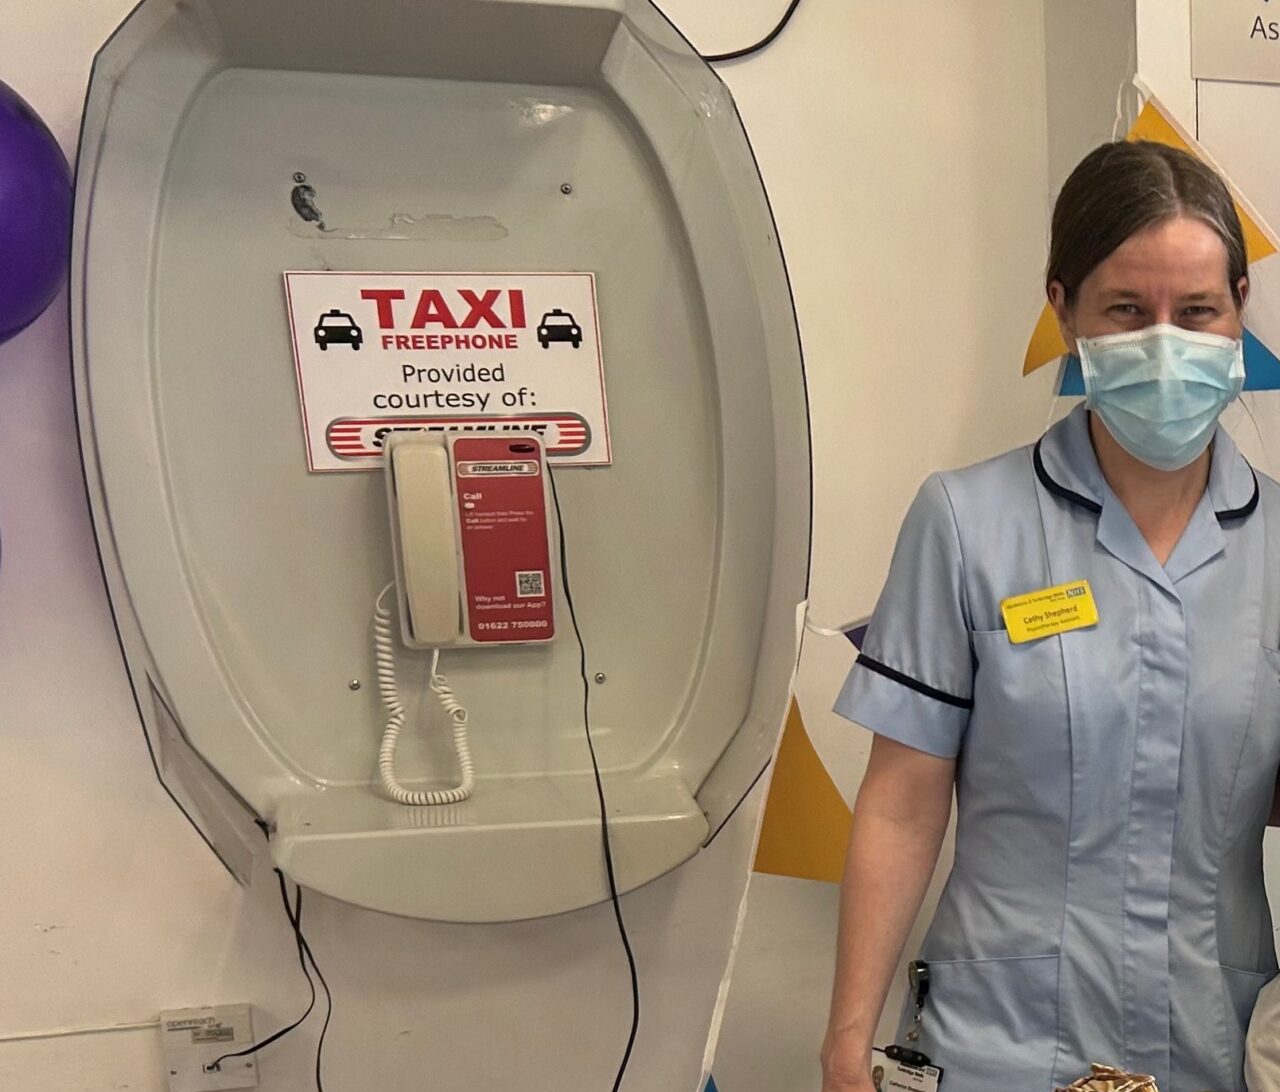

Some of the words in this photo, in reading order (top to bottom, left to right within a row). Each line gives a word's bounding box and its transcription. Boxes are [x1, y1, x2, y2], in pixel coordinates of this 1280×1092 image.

[360, 289, 526, 329] TAXI
[381, 334, 518, 350] FREEPHONE
[402, 363, 505, 383] Provided
[373, 390, 491, 411] courtesy
[502, 387, 537, 408] of:
[463, 492, 482, 500] Call
[1023, 614, 1044, 624] Cathy
[1044, 605, 1078, 619] Shepherd
[478, 622, 508, 630] 01622
